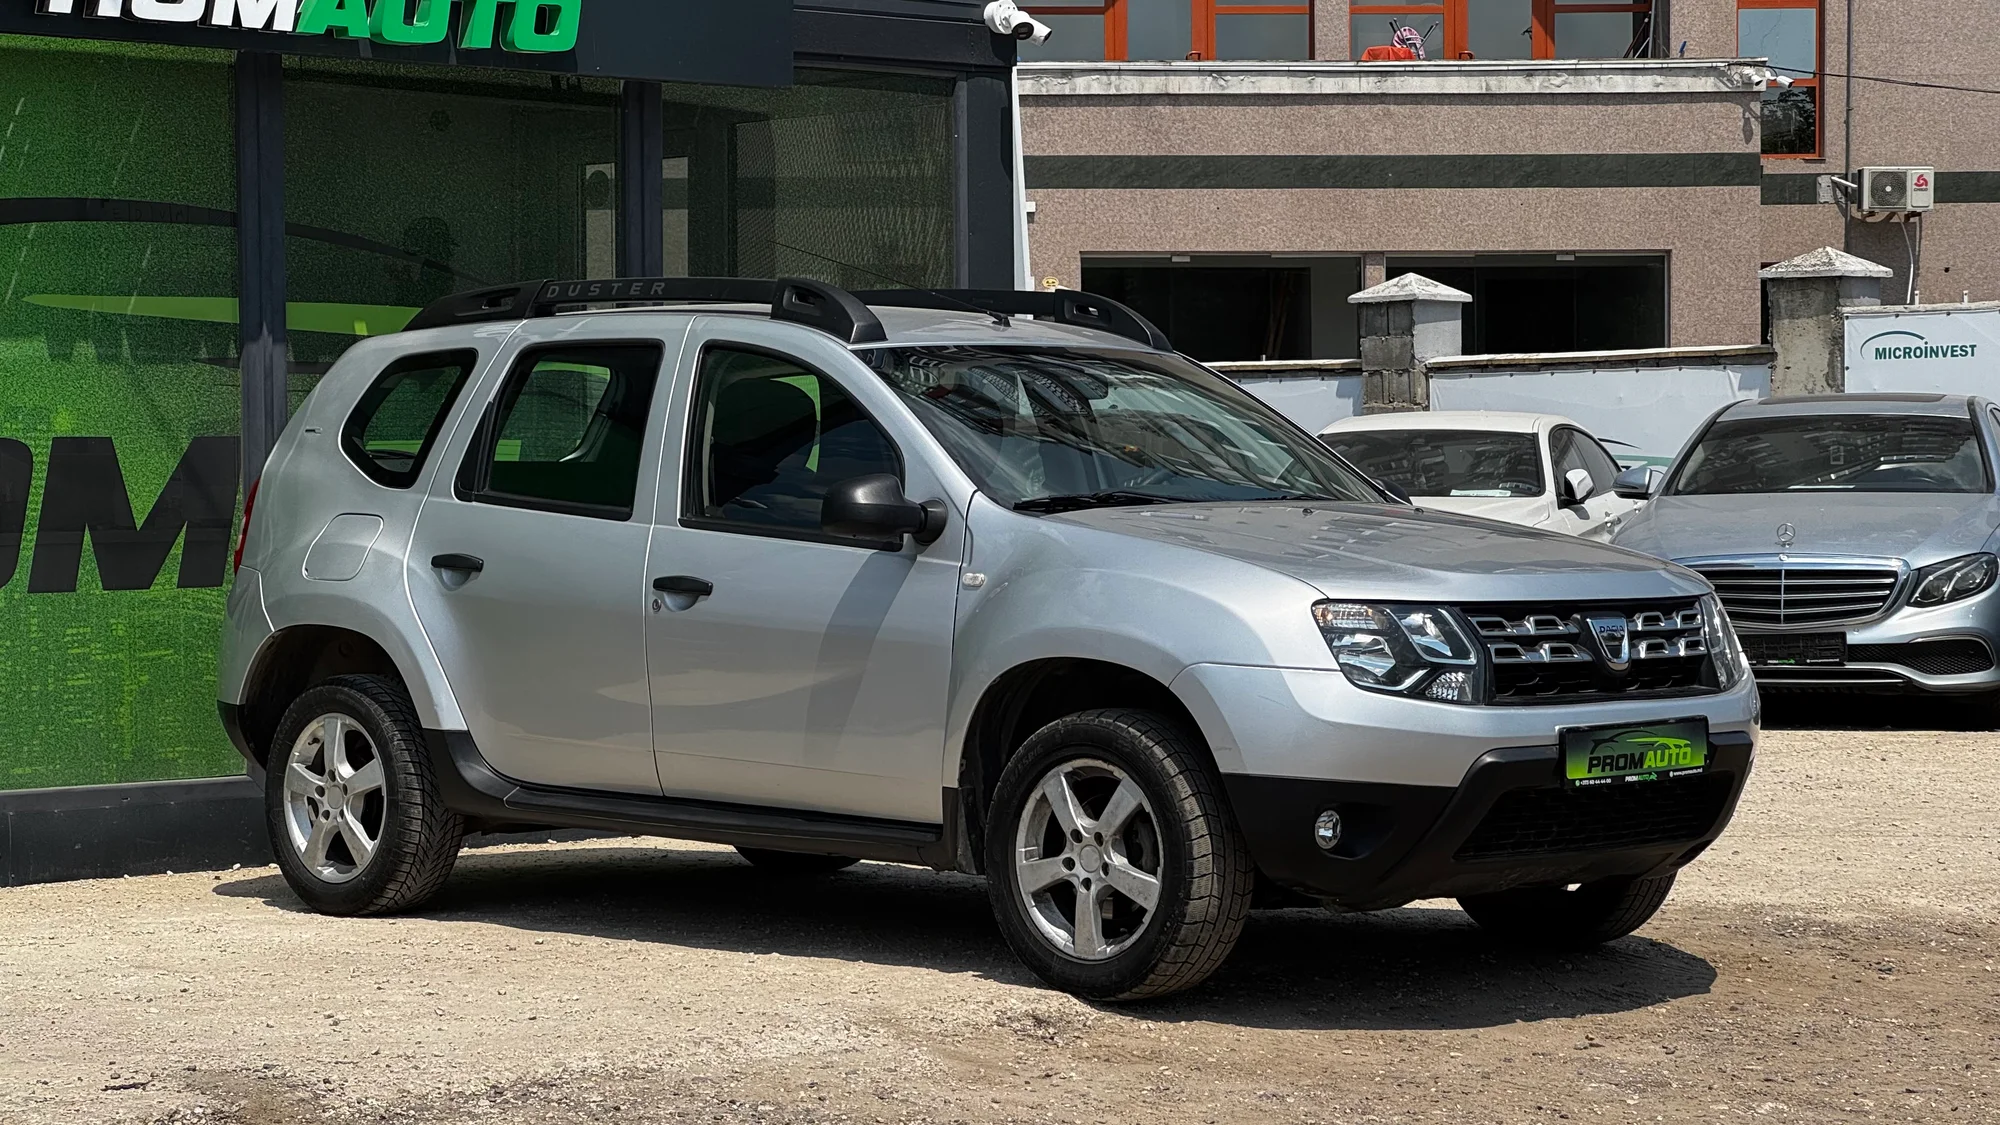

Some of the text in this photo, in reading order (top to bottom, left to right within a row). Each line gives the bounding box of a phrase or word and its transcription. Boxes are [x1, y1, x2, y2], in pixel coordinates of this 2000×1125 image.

[35, 0, 581, 52] AUTO
[547, 282, 665, 298] DUSTER
[1875, 341, 1977, 360] MICROINVEST
[1599, 625, 1624, 633] DACIA
[1587, 746, 1692, 774] PROMAUTO
